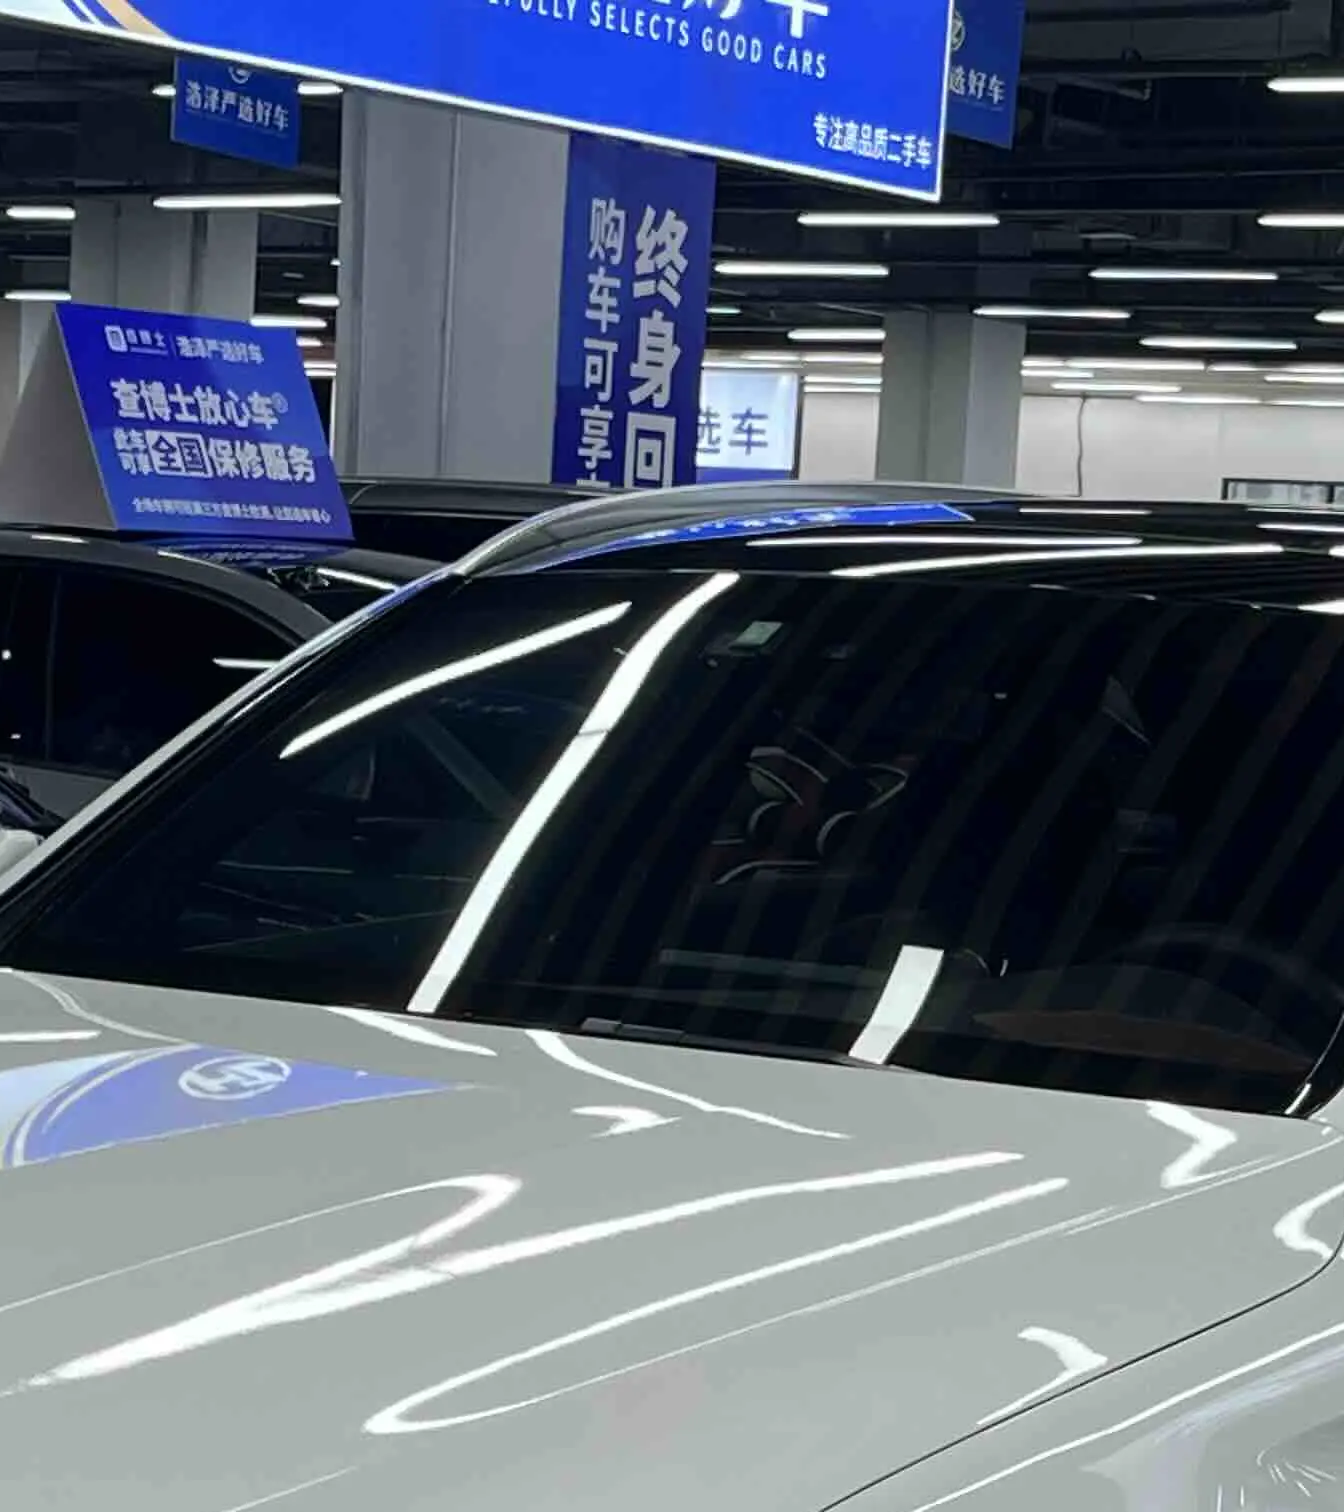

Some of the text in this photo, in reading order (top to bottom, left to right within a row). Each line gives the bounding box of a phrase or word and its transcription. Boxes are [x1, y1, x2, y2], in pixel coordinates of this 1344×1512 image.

[590, 1, 690, 48] SELECTS
[701, 26, 762, 63] GOOD
[773, 42, 828, 79] CARS
[813, 112, 932, 170] 专注高品质二手车
[576, 198, 625, 488] 购车可享
